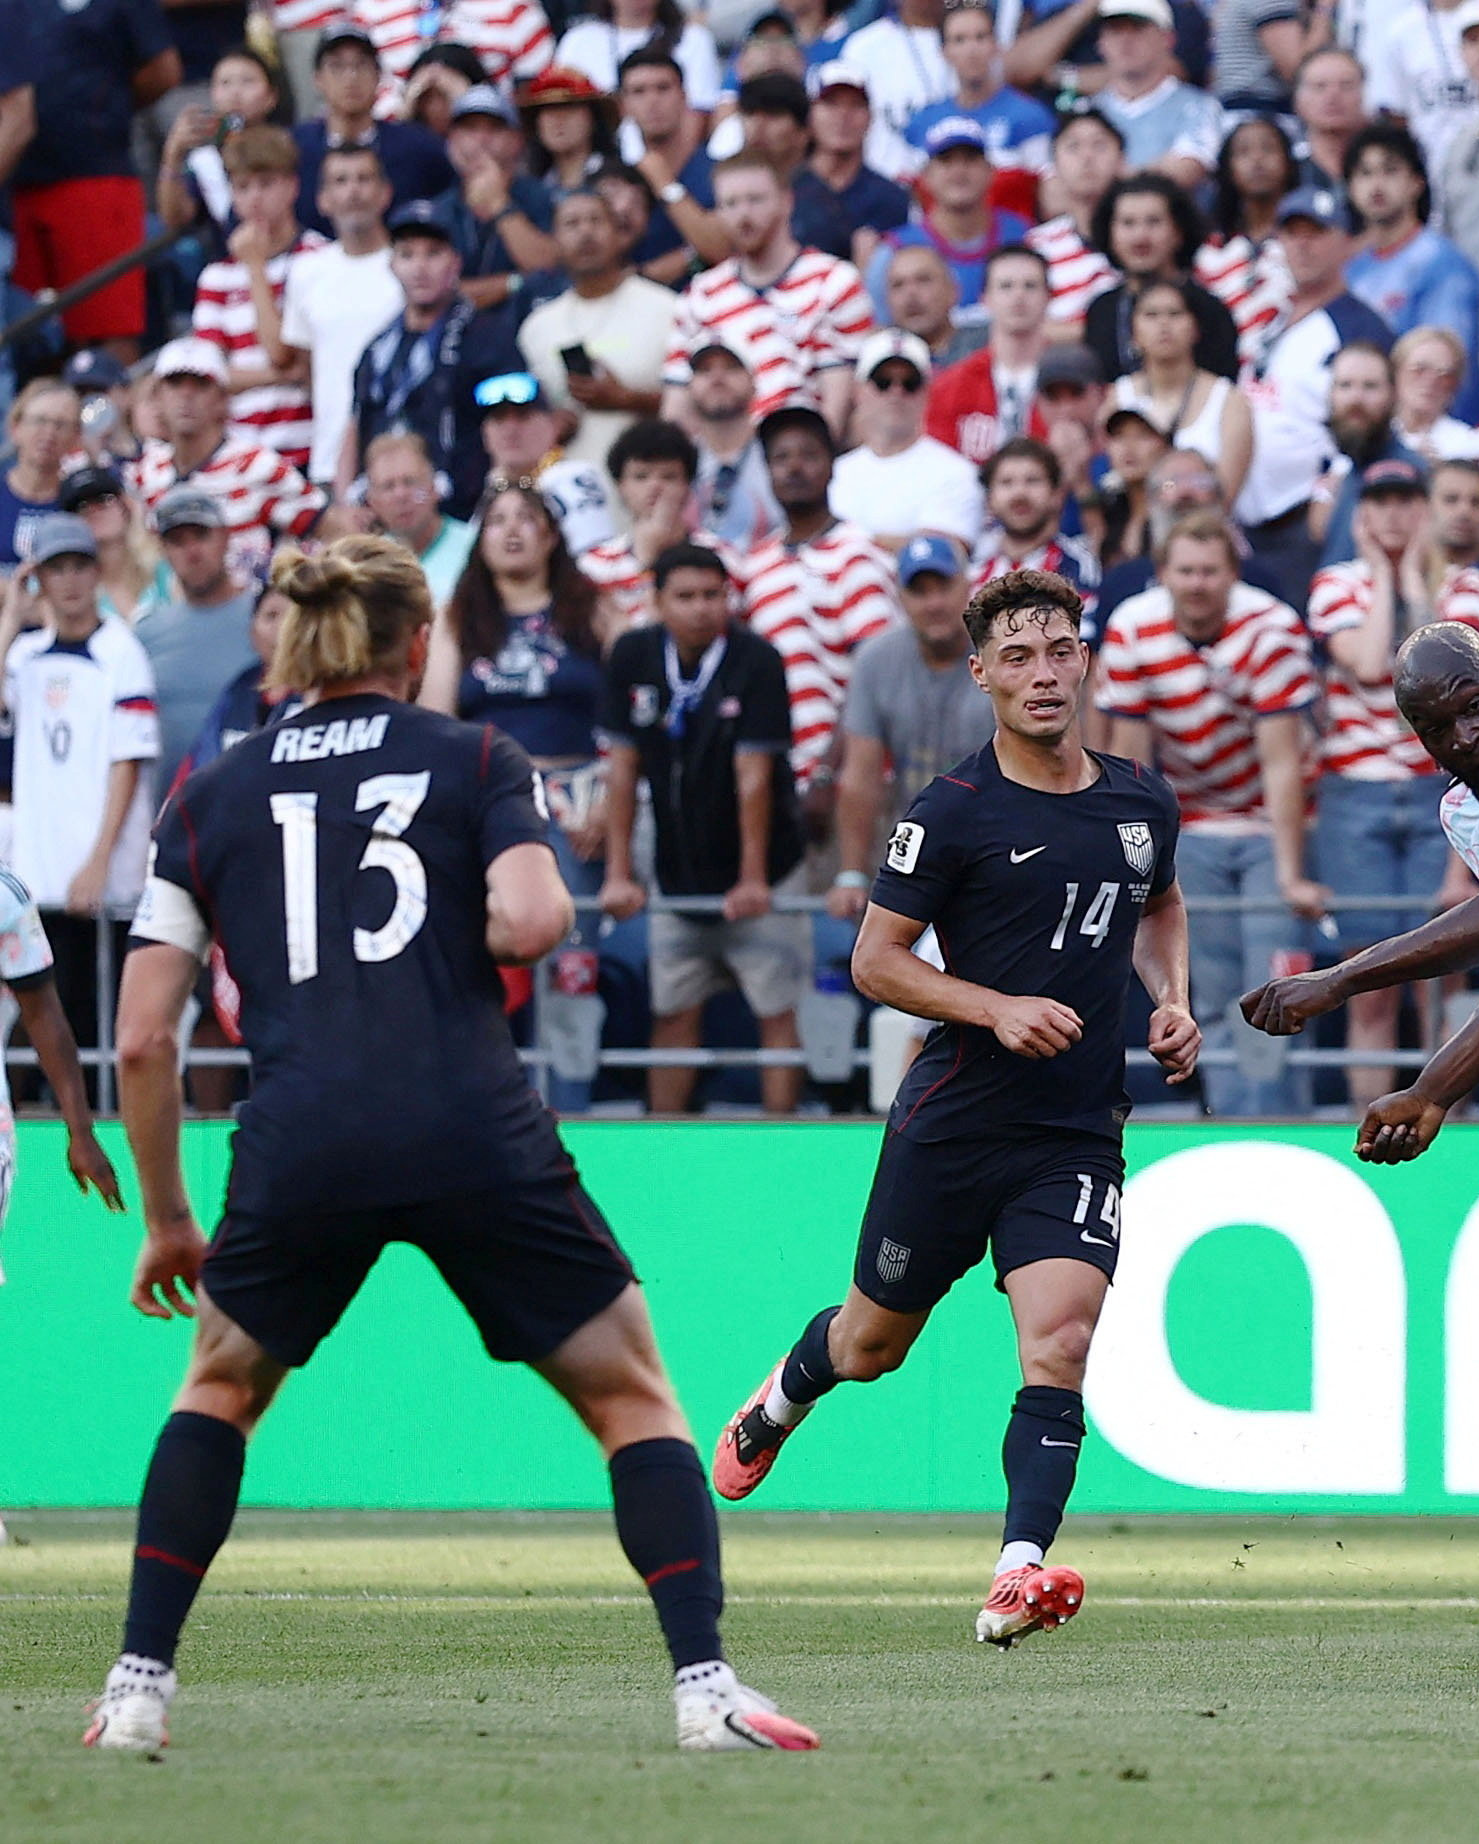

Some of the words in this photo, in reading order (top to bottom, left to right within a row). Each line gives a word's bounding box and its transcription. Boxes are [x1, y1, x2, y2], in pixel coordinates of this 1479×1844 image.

[270, 713, 391, 763] REAM
[1121, 826, 1149, 846] USA
[269, 769, 432, 985] 13
[1050, 881, 1120, 950] 14
[1073, 1173, 1120, 1241] 14
[882, 1241, 907, 1262] USA
